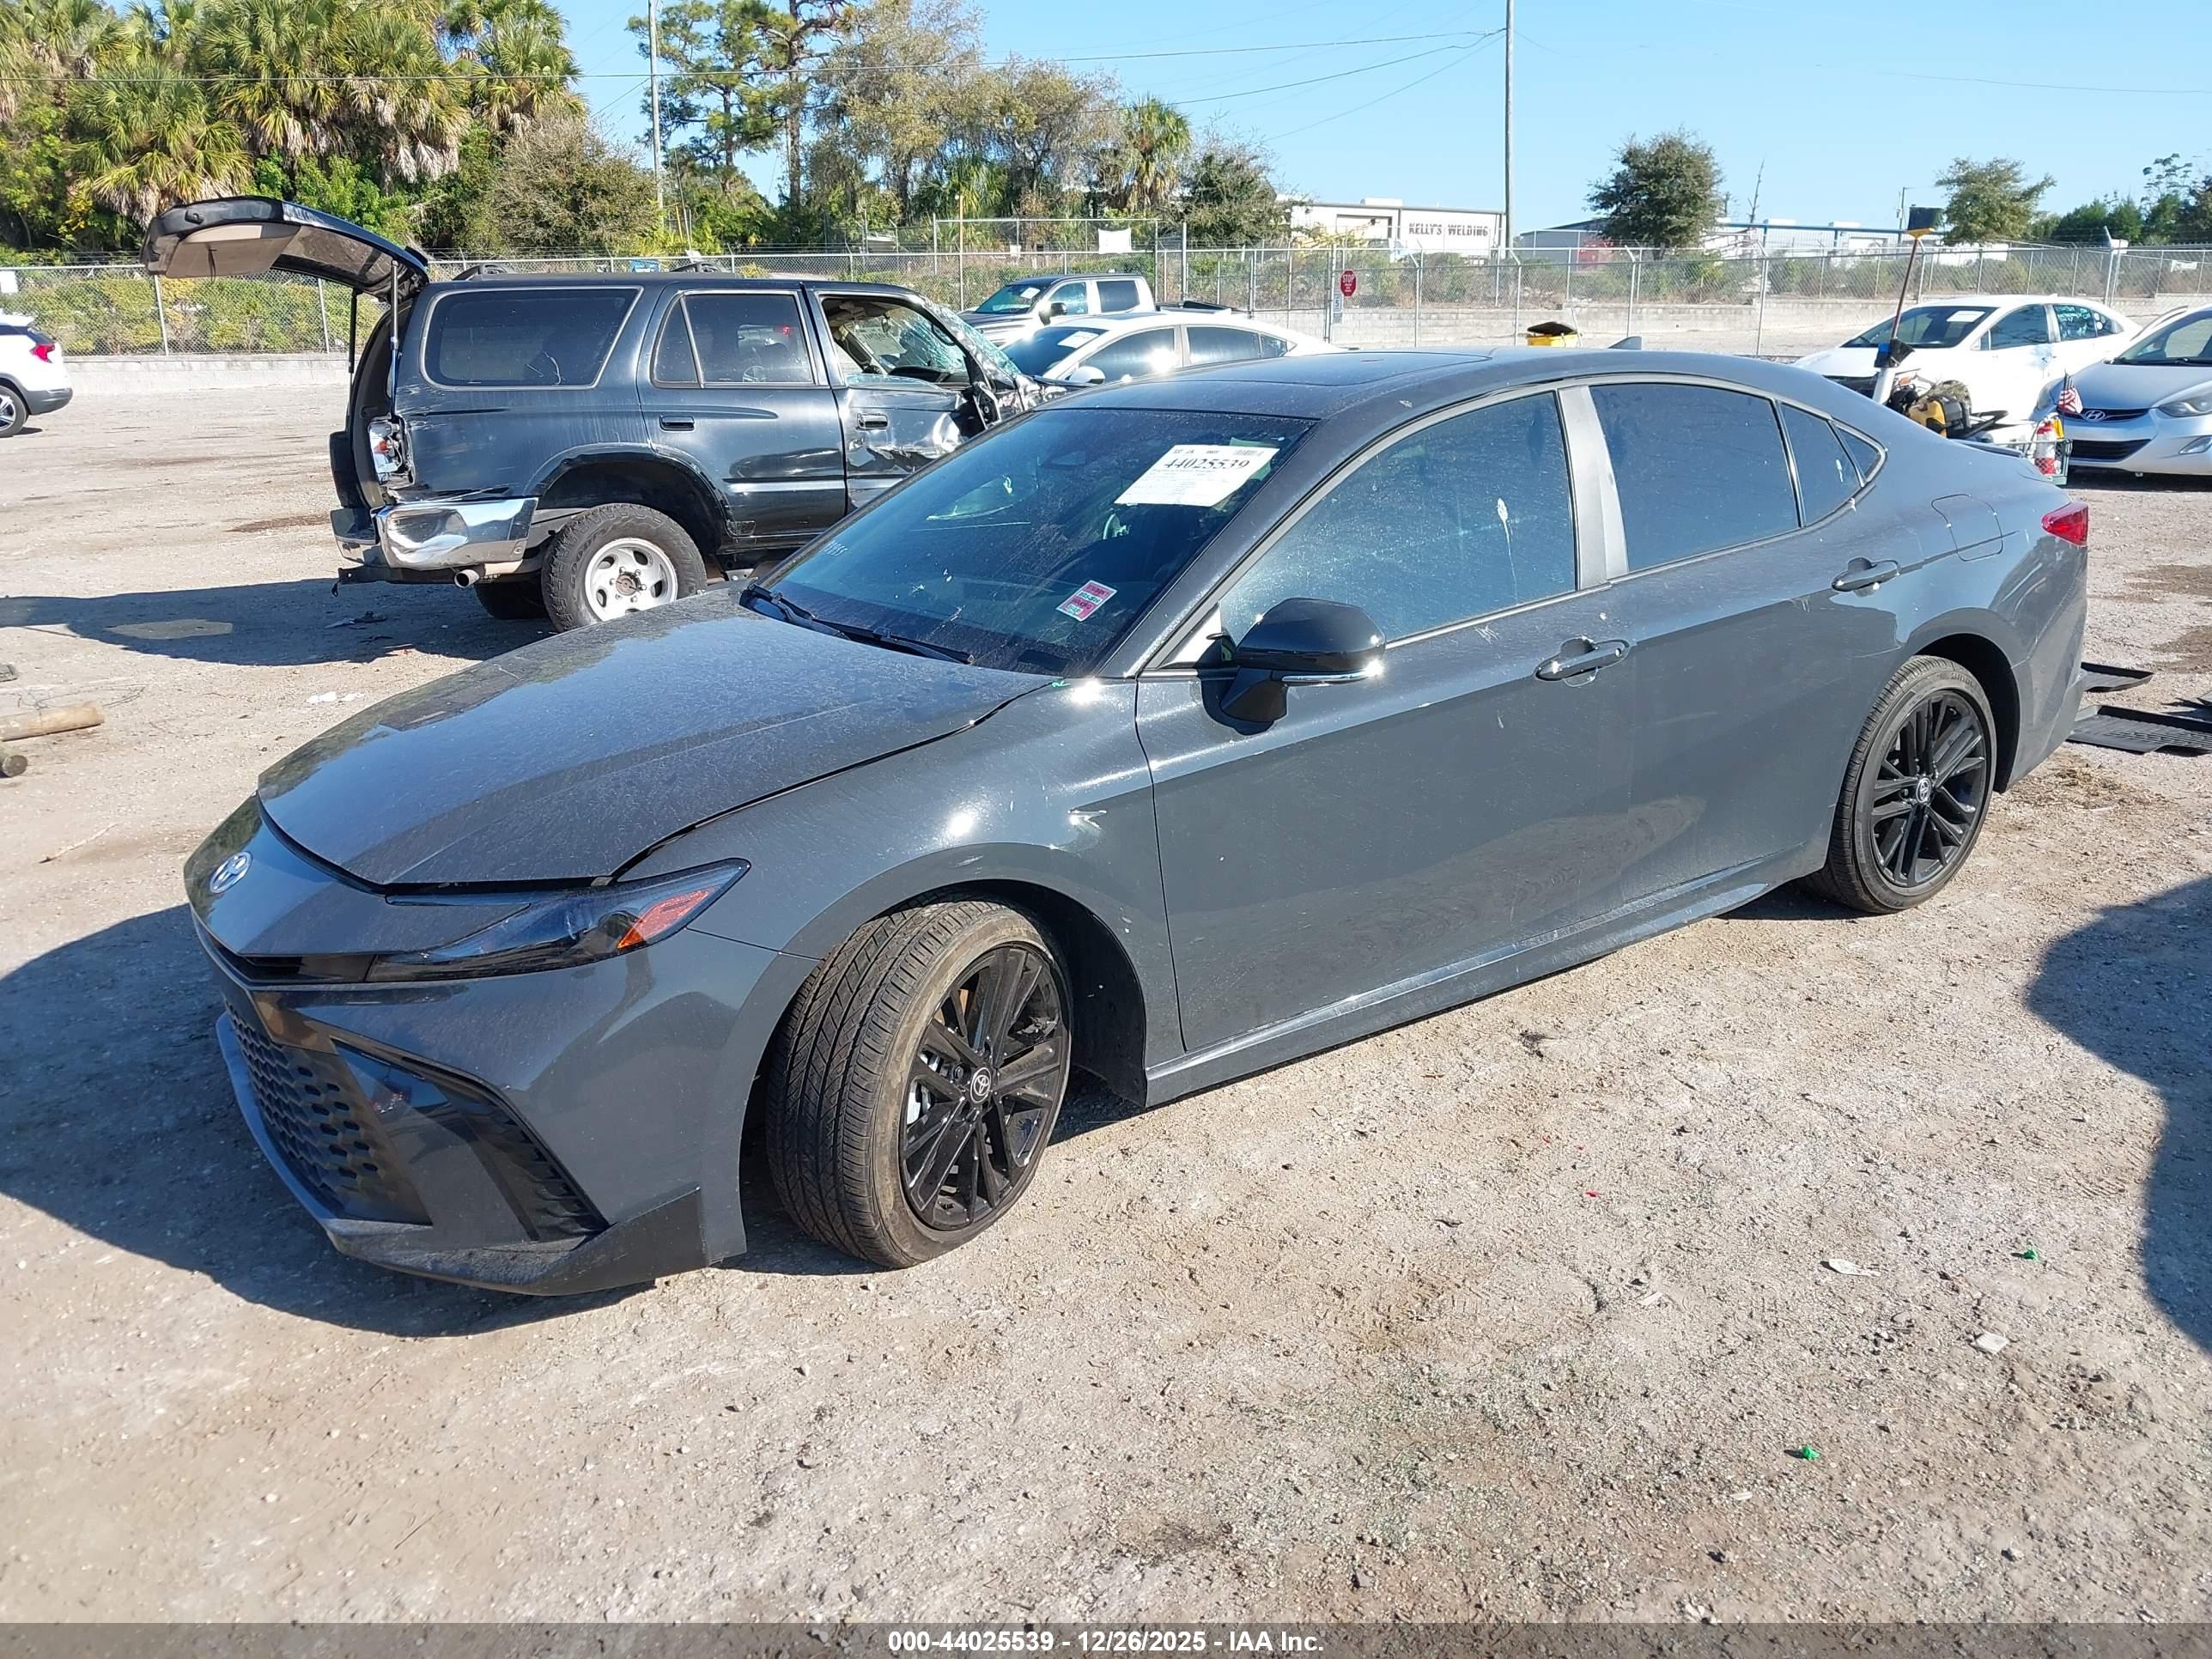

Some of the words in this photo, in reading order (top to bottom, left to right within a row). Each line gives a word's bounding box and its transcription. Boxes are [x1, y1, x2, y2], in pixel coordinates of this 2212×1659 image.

[1408, 222, 1442, 235] KELLY'S
[1448, 223, 1489, 236] WELDING
[1342, 274, 1354, 283] STOP
[1163, 459, 1250, 469] 44025539
